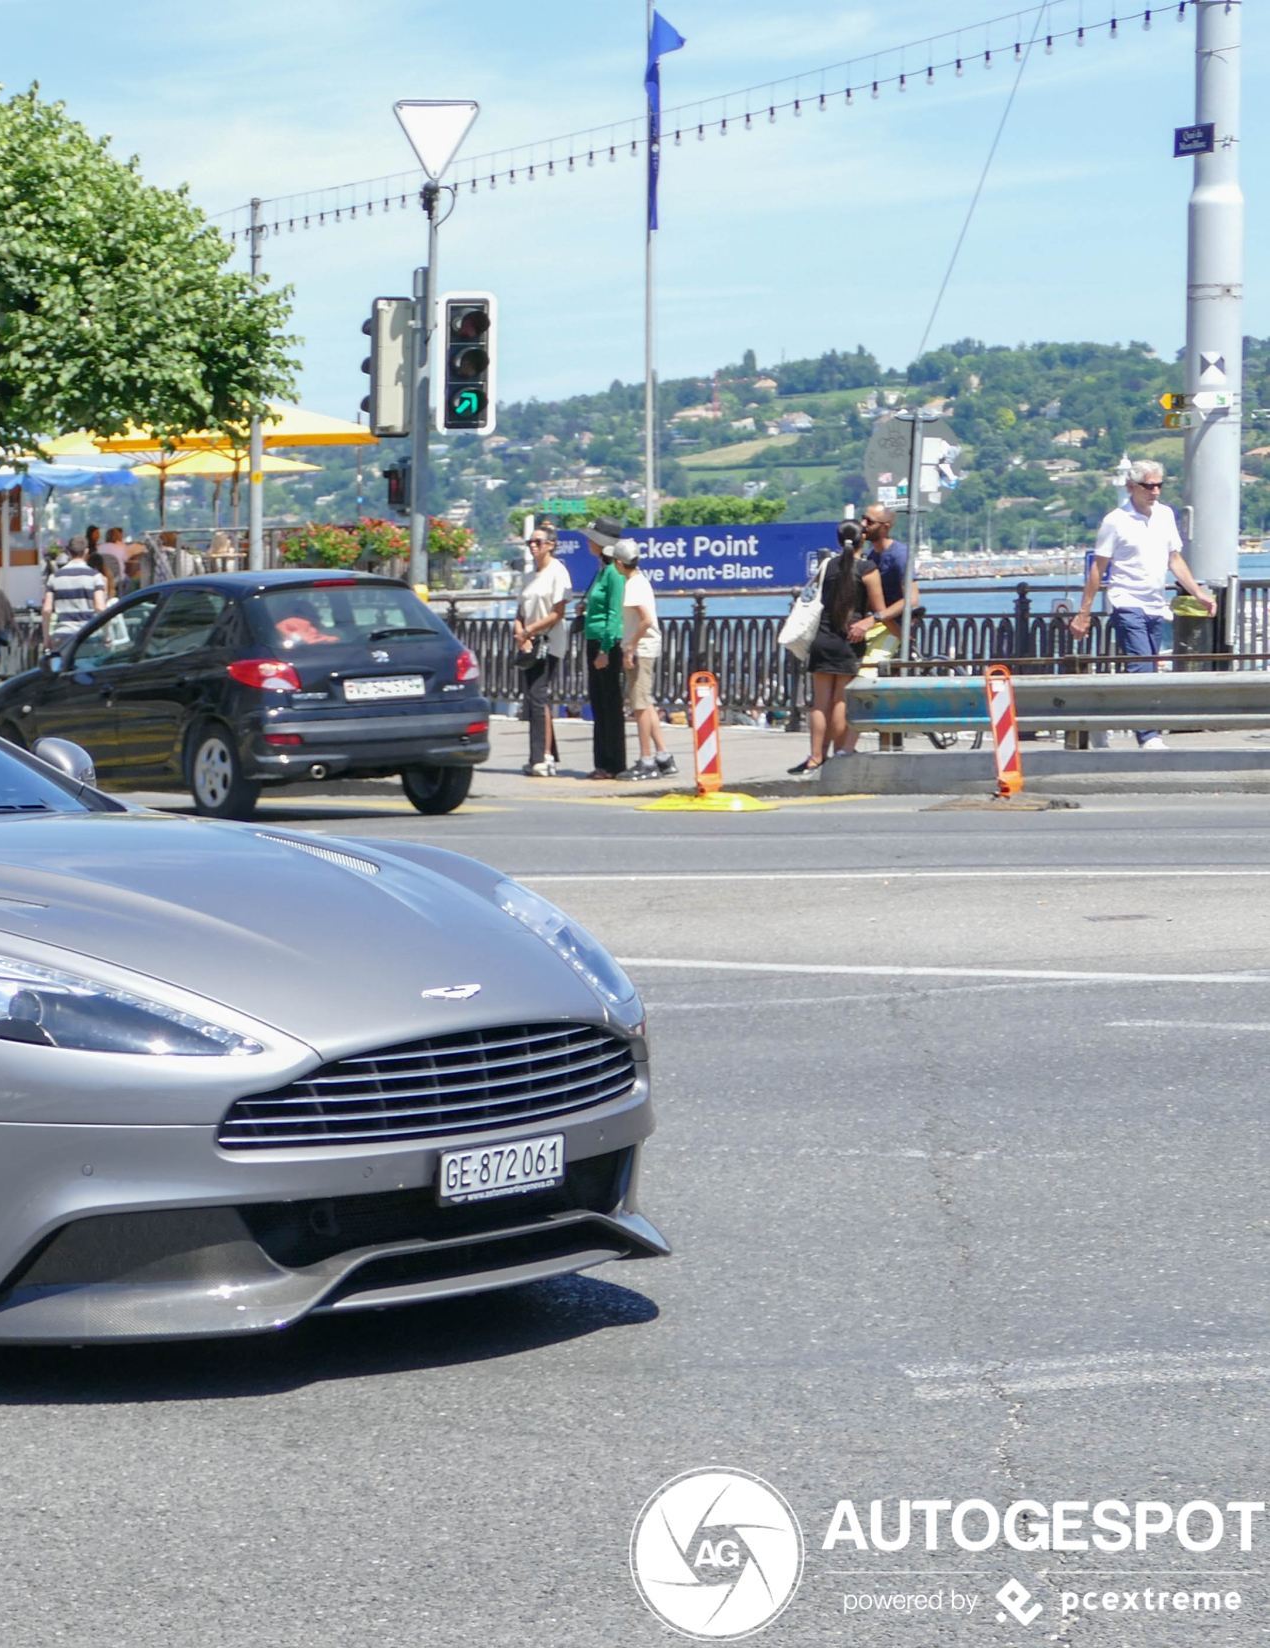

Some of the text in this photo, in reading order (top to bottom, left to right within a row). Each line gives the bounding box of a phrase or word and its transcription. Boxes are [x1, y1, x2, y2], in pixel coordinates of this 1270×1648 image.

[636, 535, 759, 559] cket Point
[668, 562, 774, 582] Mont-Blanc
